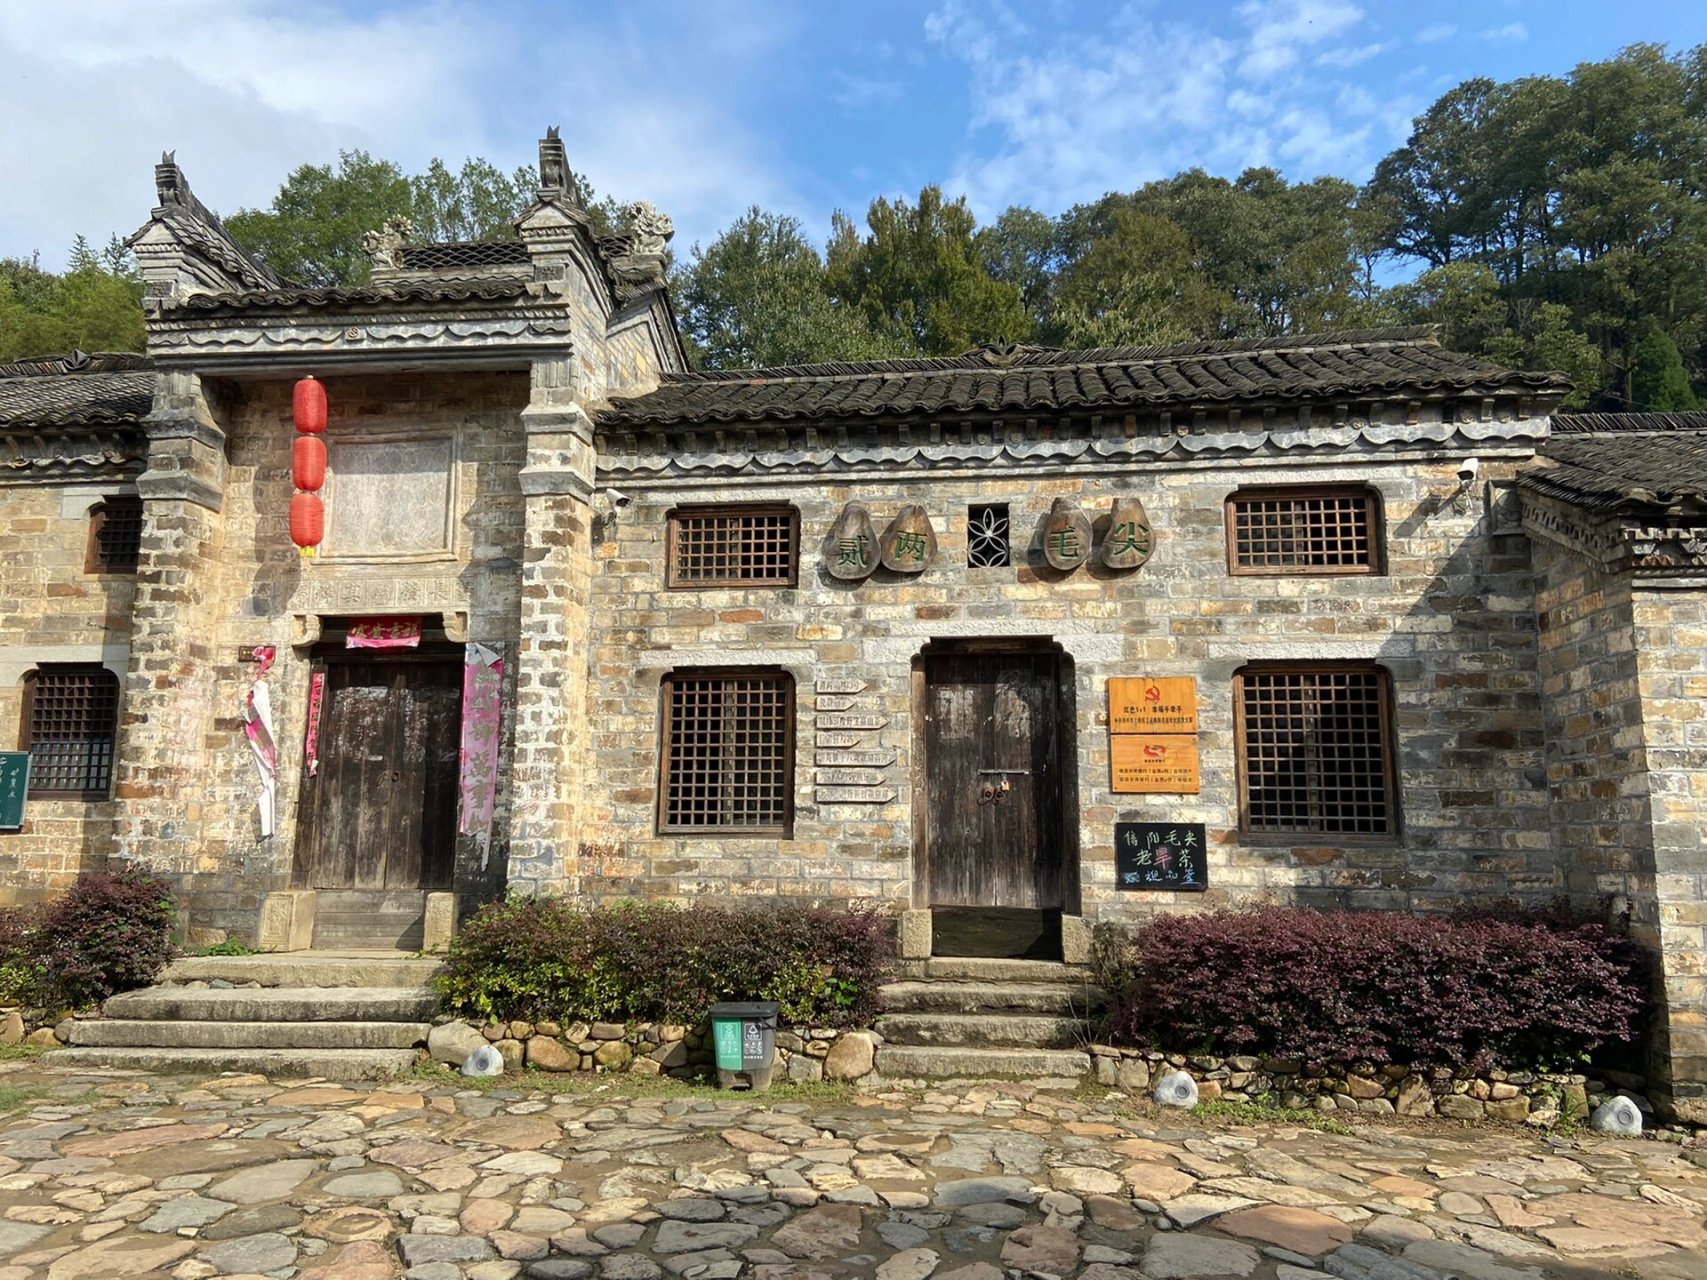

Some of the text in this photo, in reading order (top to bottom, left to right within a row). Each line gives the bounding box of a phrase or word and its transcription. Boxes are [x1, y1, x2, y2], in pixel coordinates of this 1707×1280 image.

[838, 521, 1149, 568] 贰两 毛尖
[1123, 830, 1198, 849] 信阳毛尖
